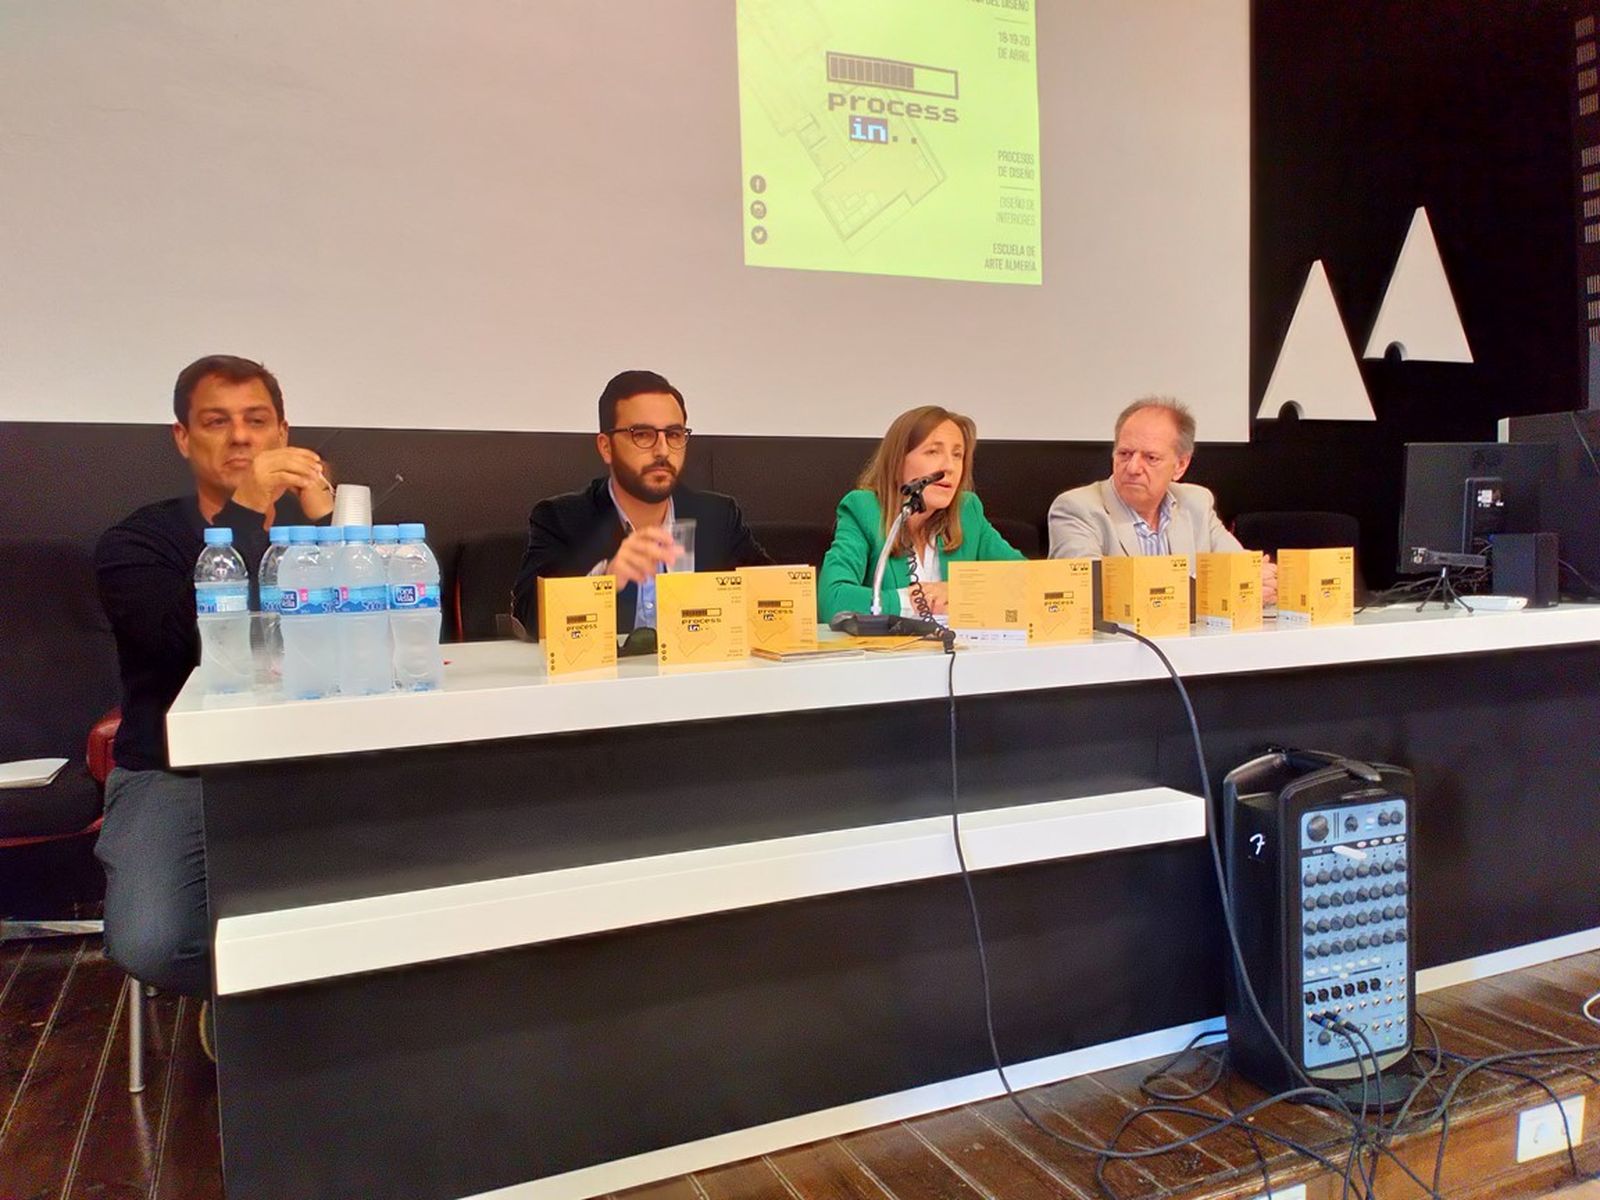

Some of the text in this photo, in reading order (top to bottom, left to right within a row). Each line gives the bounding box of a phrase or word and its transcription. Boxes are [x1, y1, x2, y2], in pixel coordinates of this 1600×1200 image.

[827, 92, 960, 123] process
[998, 150, 1034, 165] PROCESOS
[998, 166, 1008, 177] DE
[993, 243, 1036, 257] ESCUELA DE
[984, 258, 1003, 270] ARTE
[681, 617, 722, 625] process
[1250, 833, 1266, 855] 7
